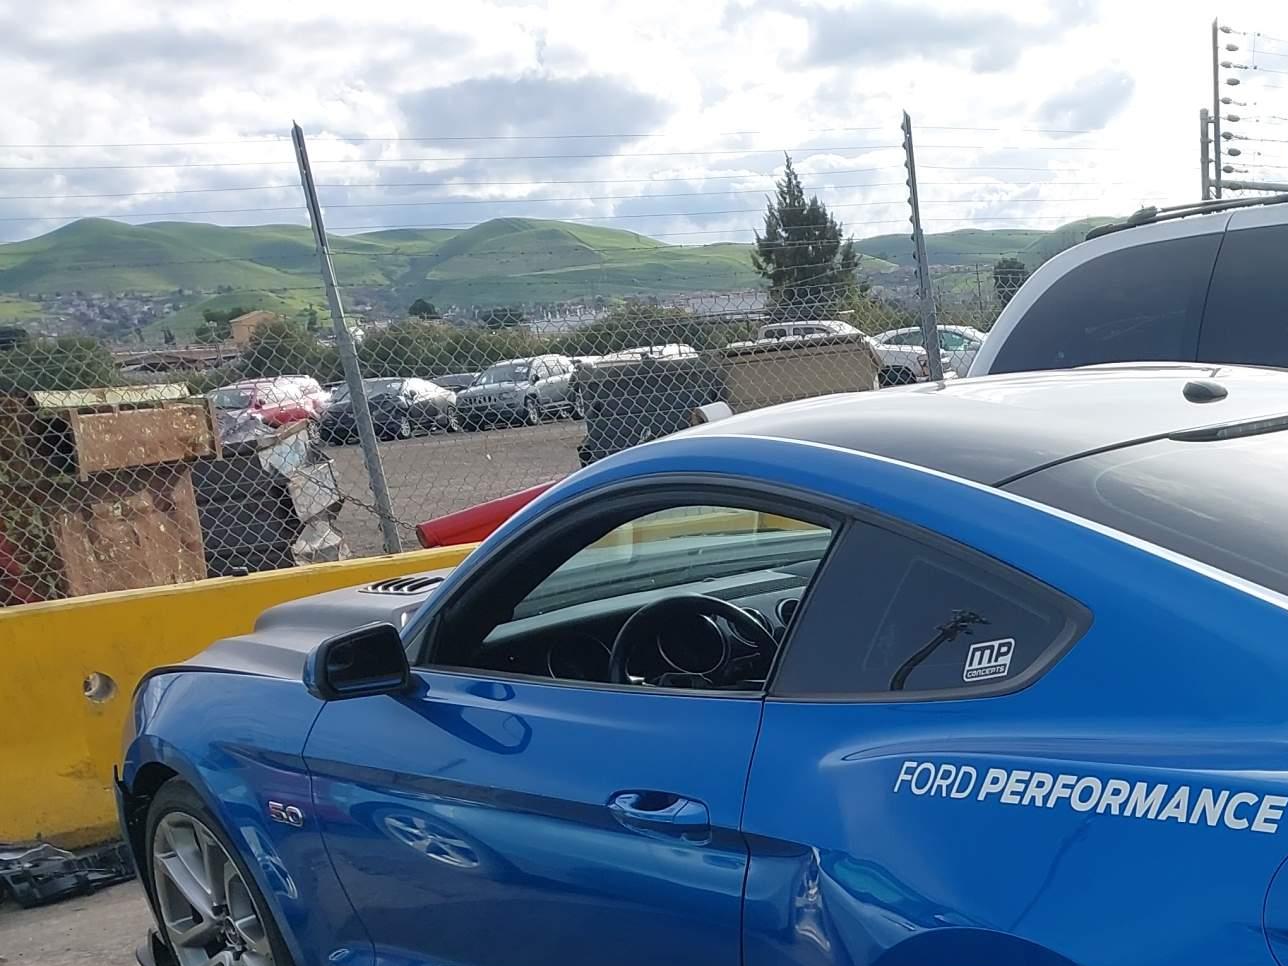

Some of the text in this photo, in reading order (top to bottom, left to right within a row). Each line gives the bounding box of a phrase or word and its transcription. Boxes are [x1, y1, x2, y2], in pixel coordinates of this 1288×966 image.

[968, 641, 1012, 668] MP
[893, 761, 1288, 833] FORD PERFORMANCE
